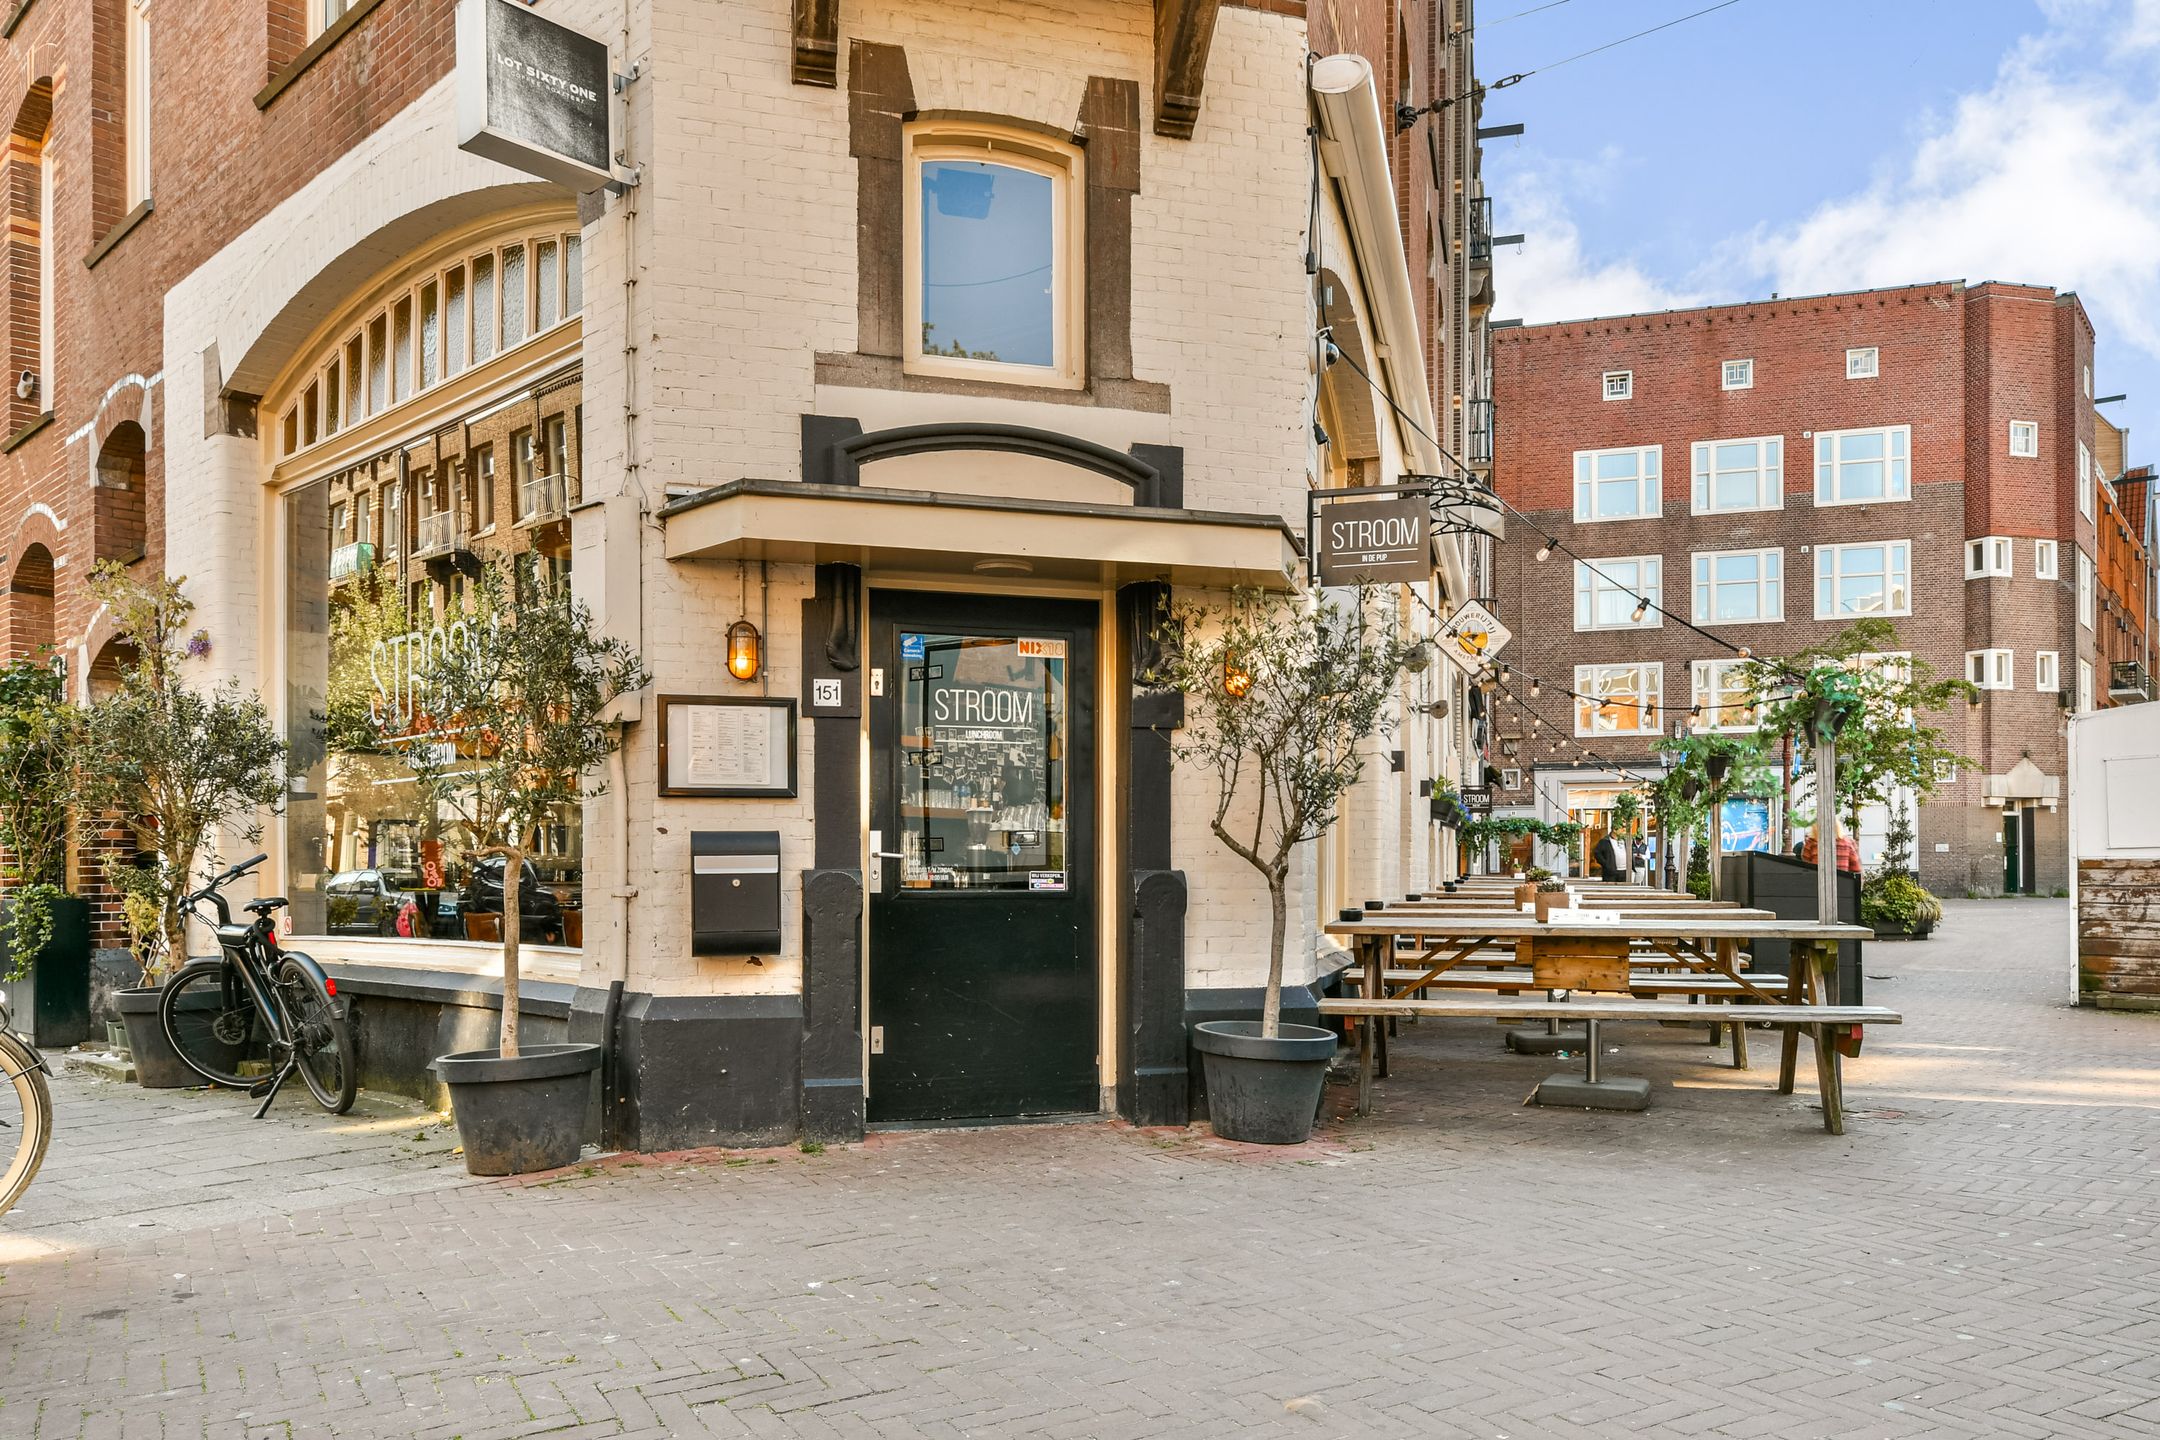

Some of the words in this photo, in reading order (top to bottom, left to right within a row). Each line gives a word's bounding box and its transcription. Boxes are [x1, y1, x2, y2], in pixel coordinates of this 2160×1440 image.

[497, 53, 522, 71] LOT
[526, 66, 567, 89] SIXTY
[569, 83, 597, 102] ONE
[1332, 517, 1418, 549] STROOM
[1361, 554, 1368, 562] IN
[1369, 554, 1376, 562] DE
[1452, 612, 1487, 631] ROUWERIJ
[1020, 641, 1064, 656] NIX18
[815, 685, 839, 700] 151
[935, 688, 1032, 723] STROOM
[965, 729, 1004, 740] LUNCHROOM
[1463, 794, 1490, 804] STROOM
